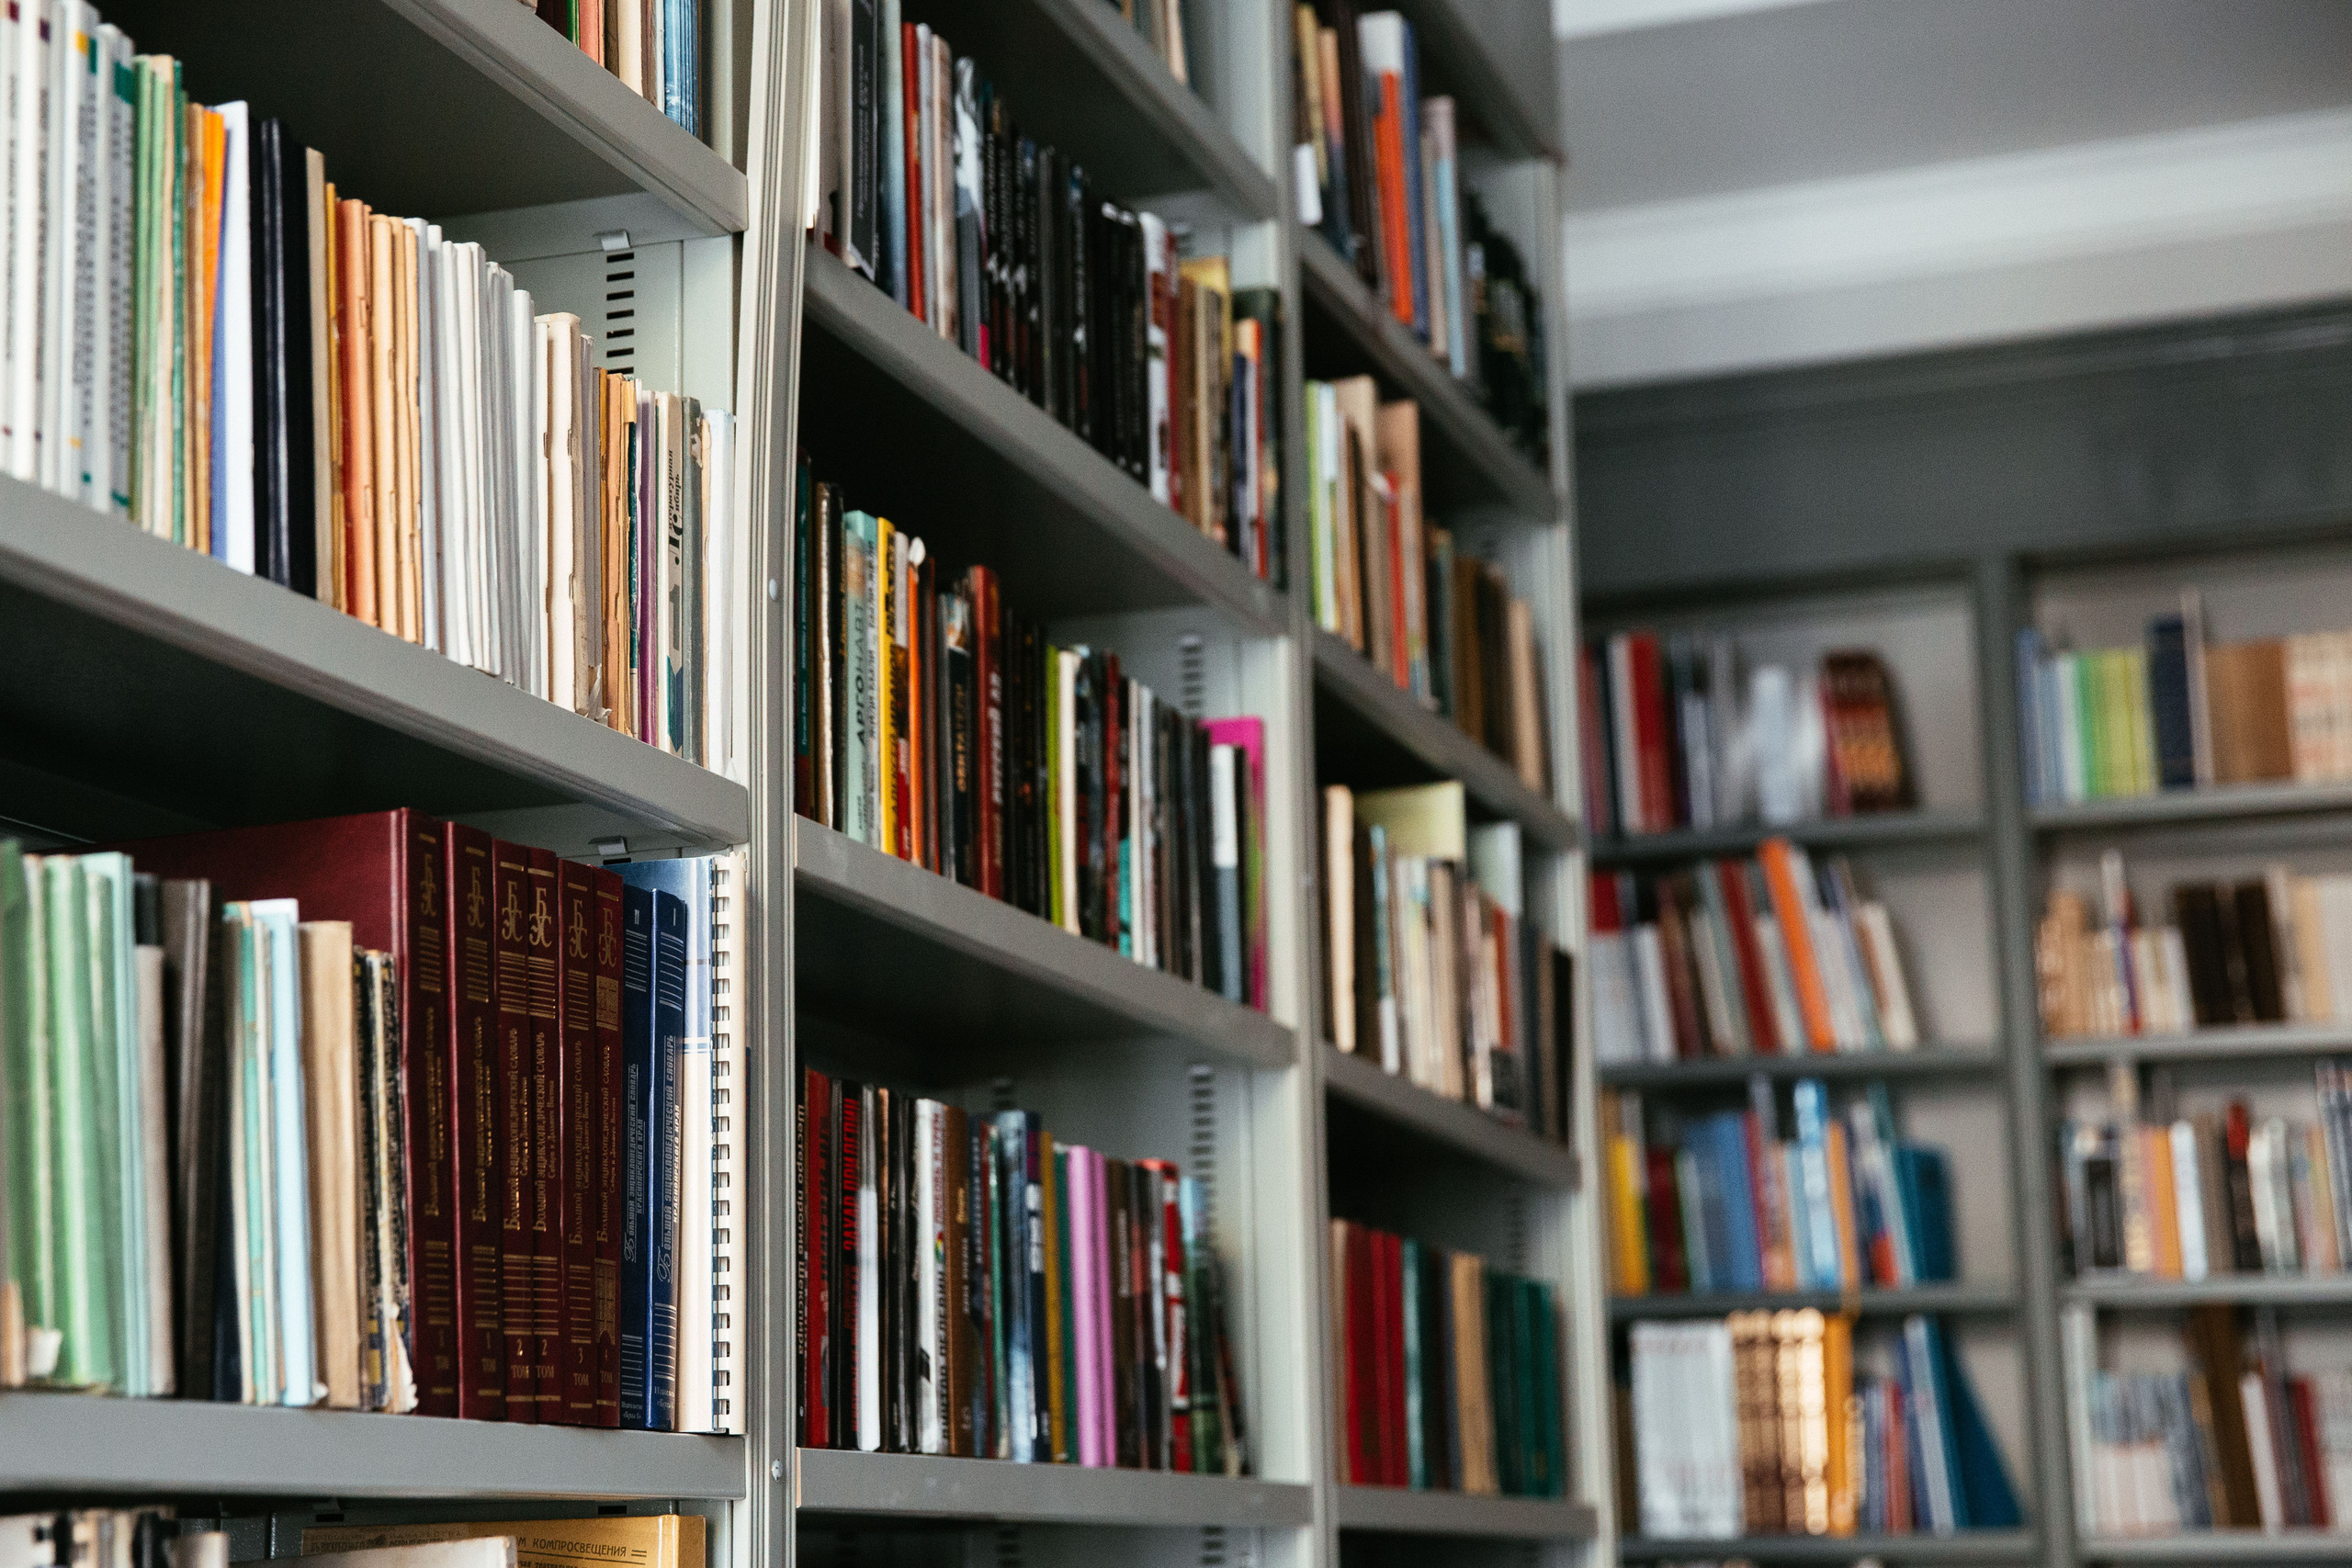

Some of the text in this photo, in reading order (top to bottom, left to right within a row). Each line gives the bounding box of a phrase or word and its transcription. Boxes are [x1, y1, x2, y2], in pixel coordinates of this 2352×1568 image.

[668, 449, 680, 566] Литературная
[673, 473, 683, 536] Сибирь
[854, 603, 865, 746] АРГОНАВТ
[628, 1064, 637, 1100] СЛОВАРЬ
[503, 1028, 520, 1230] БОЛЬШОЙ ЭНЦИКЛОПЕДИЧЕСКИЙ СЛОВАРЬ
[533, 1032, 547, 1232] БОЛЬШОЙ ЭНЦИКЛОПЕДИЧЕСКИЙ СЛОВАРЬ
[569, 1041, 584, 1245] БОЛЬШОЙ ЭНЦИКЛОПЕДИЧЕСКИЙ СЛОВАРЬ
[600, 1088, 609, 1188] ЭНЦИКЛОПЕДИЧЕСКИЙ
[658, 1035, 674, 1282] БОЛЬШОЙ ЭНЦИКЛОПЕДИЧЕСКИЙ СЛОВАРЬ
[842, 1098, 860, 1192] ПРИЛЕПИН
[596, 1192, 609, 1242] БОЛЬШОЙ
[624, 1200, 636, 1262] БОЛЬШОЙ
[797, 1104, 806, 1355] Шестеро против Шекспира
[842, 1194, 858, 1251] ЗАХАР
[511, 1365, 529, 1380] ТОМ
[516, 1338, 524, 1357] 2
[536, 1365, 554, 1379] ТОМ
[541, 1338, 548, 1356] 2
[578, 1348, 583, 1364] 3
[572, 1372, 589, 1387] ТОМ
[600, 1370, 614, 1384] ТОМ
[533, 1538, 628, 1557] КОМПРОСВЕЩЕНИЯ
